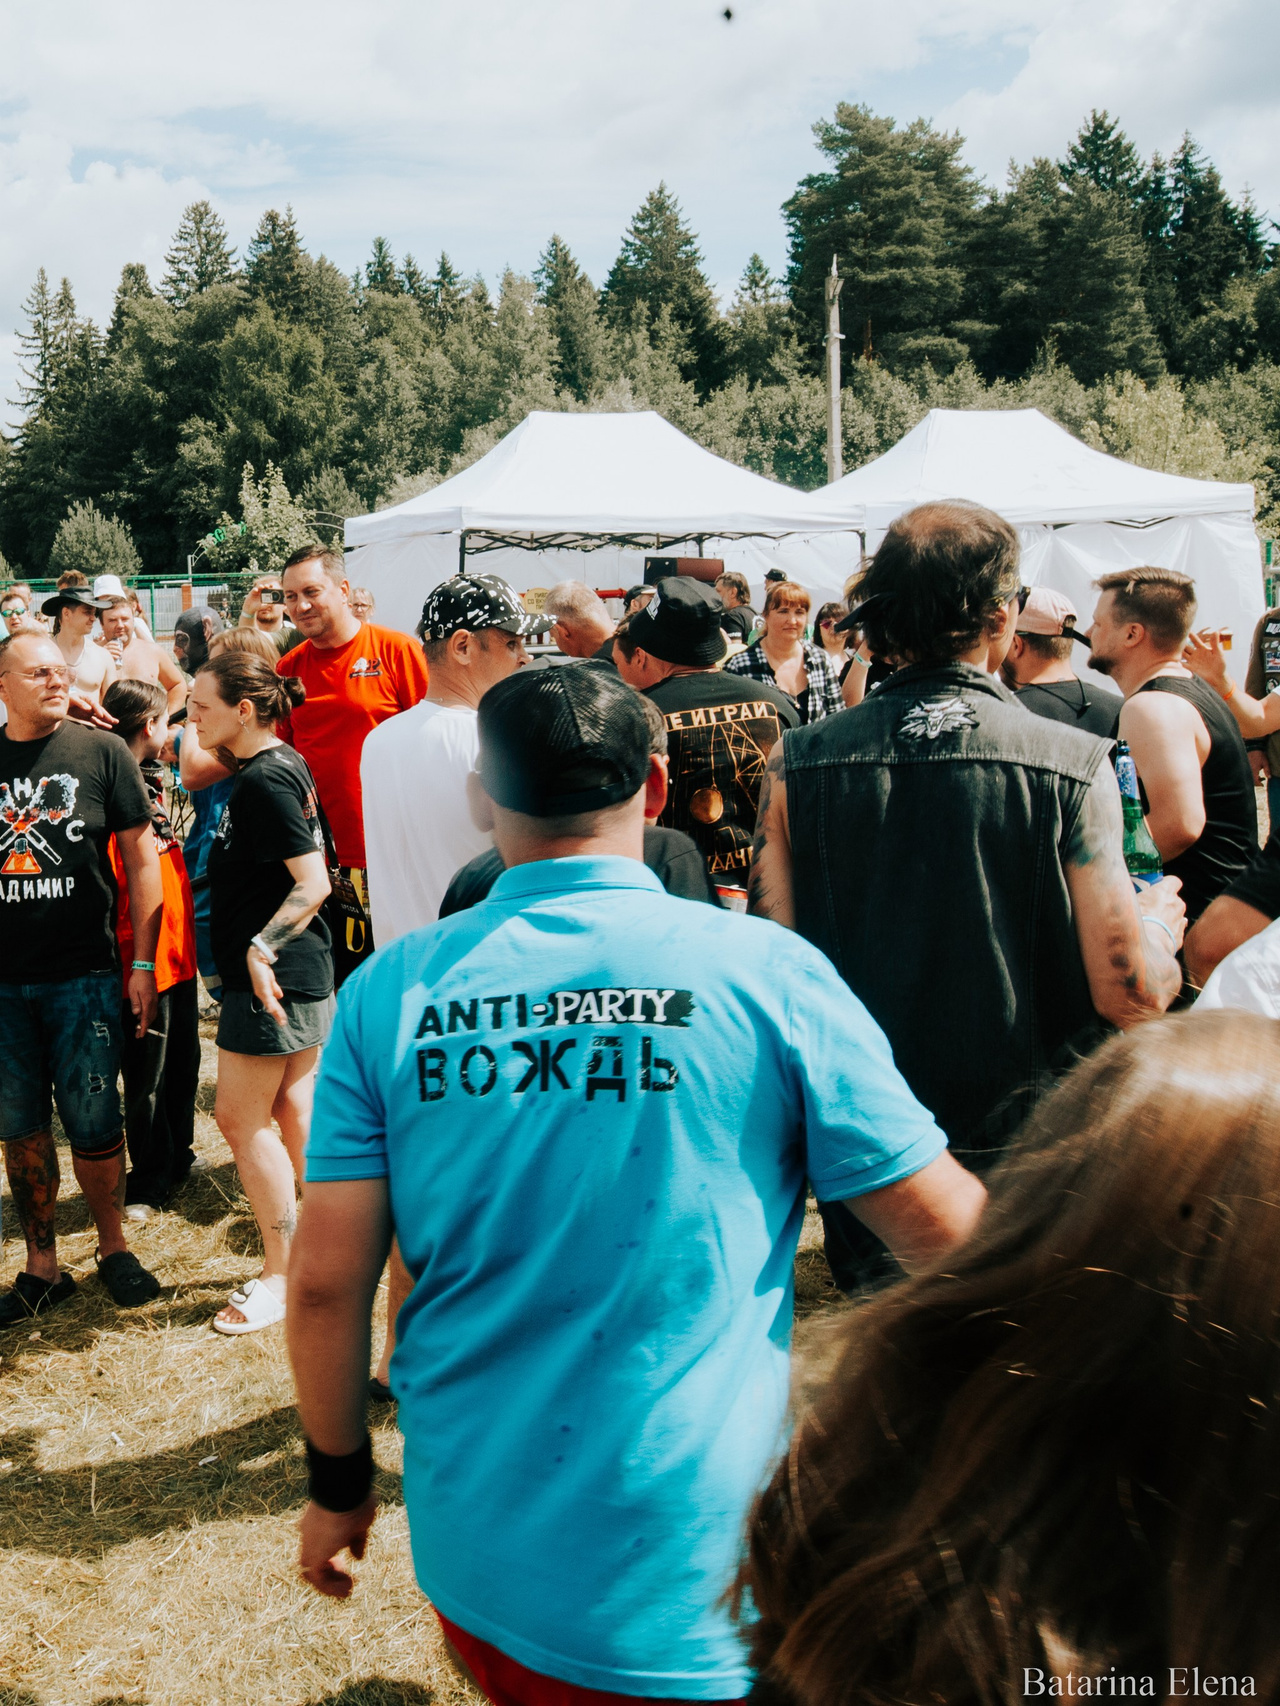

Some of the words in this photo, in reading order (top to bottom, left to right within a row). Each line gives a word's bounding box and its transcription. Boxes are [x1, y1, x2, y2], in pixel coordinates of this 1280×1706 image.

[706, 846, 754, 874] ДАЧ
[415, 988, 677, 1039] ANTI-PARTY
[416, 1035, 680, 1103] ВОЖДЬ
